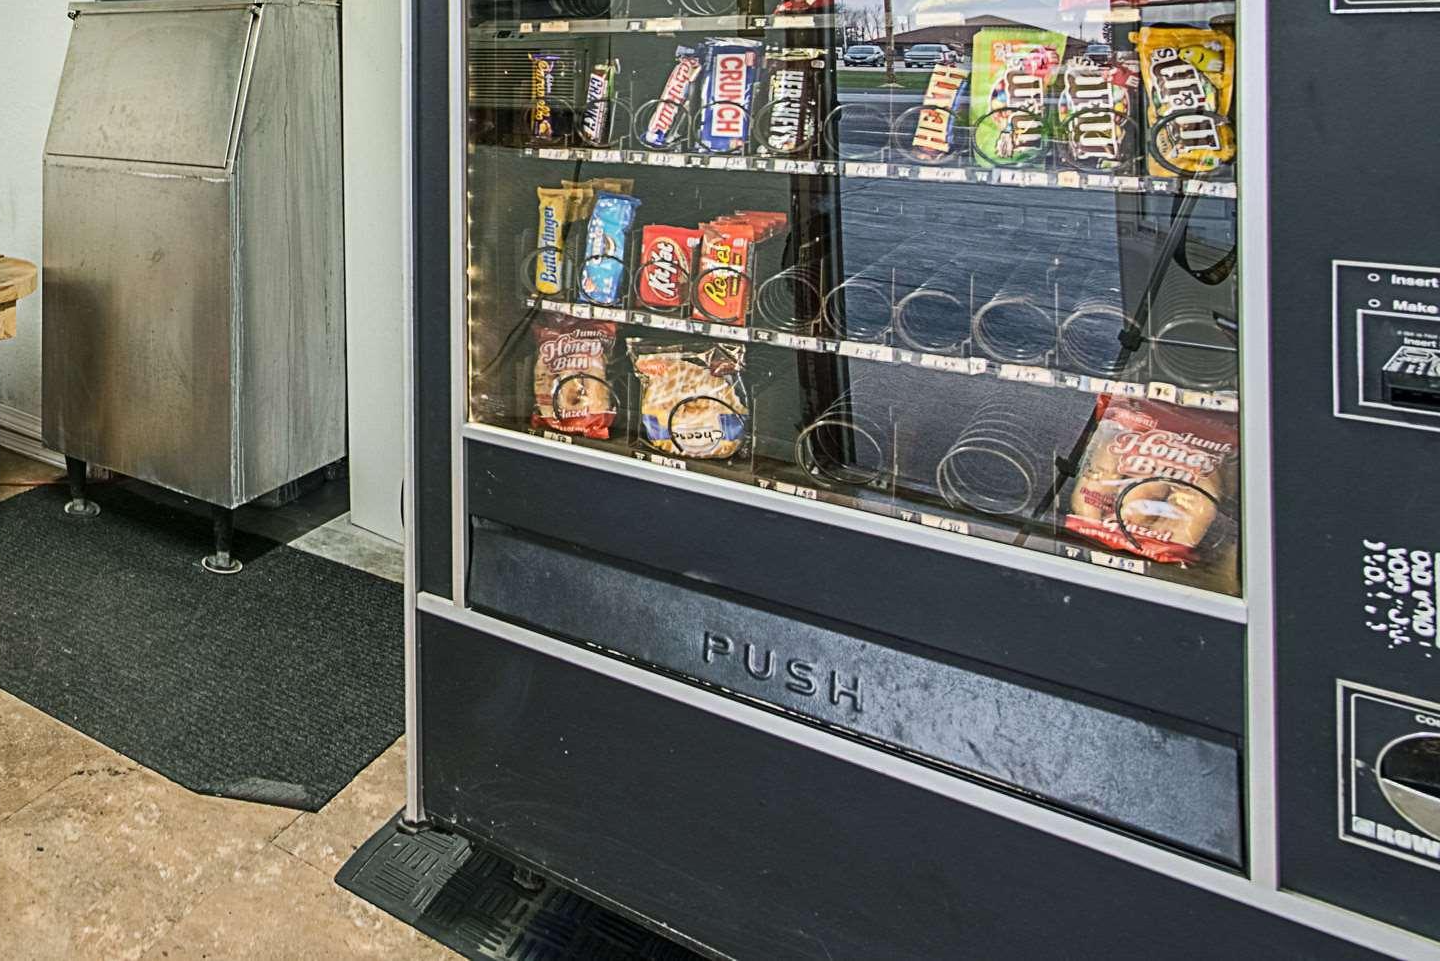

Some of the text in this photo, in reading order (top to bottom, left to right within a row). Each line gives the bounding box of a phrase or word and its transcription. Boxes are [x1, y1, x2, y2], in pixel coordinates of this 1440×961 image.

[716, 56, 744, 133] CRUNCH
[1390, 273, 1440, 289] Insert
[1392, 299, 1439, 315] Make
[544, 338, 603, 361] Honey
[552, 357, 589, 371] Bun
[1110, 432, 1222, 475] Honey
[701, 629, 864, 714] PUSH
